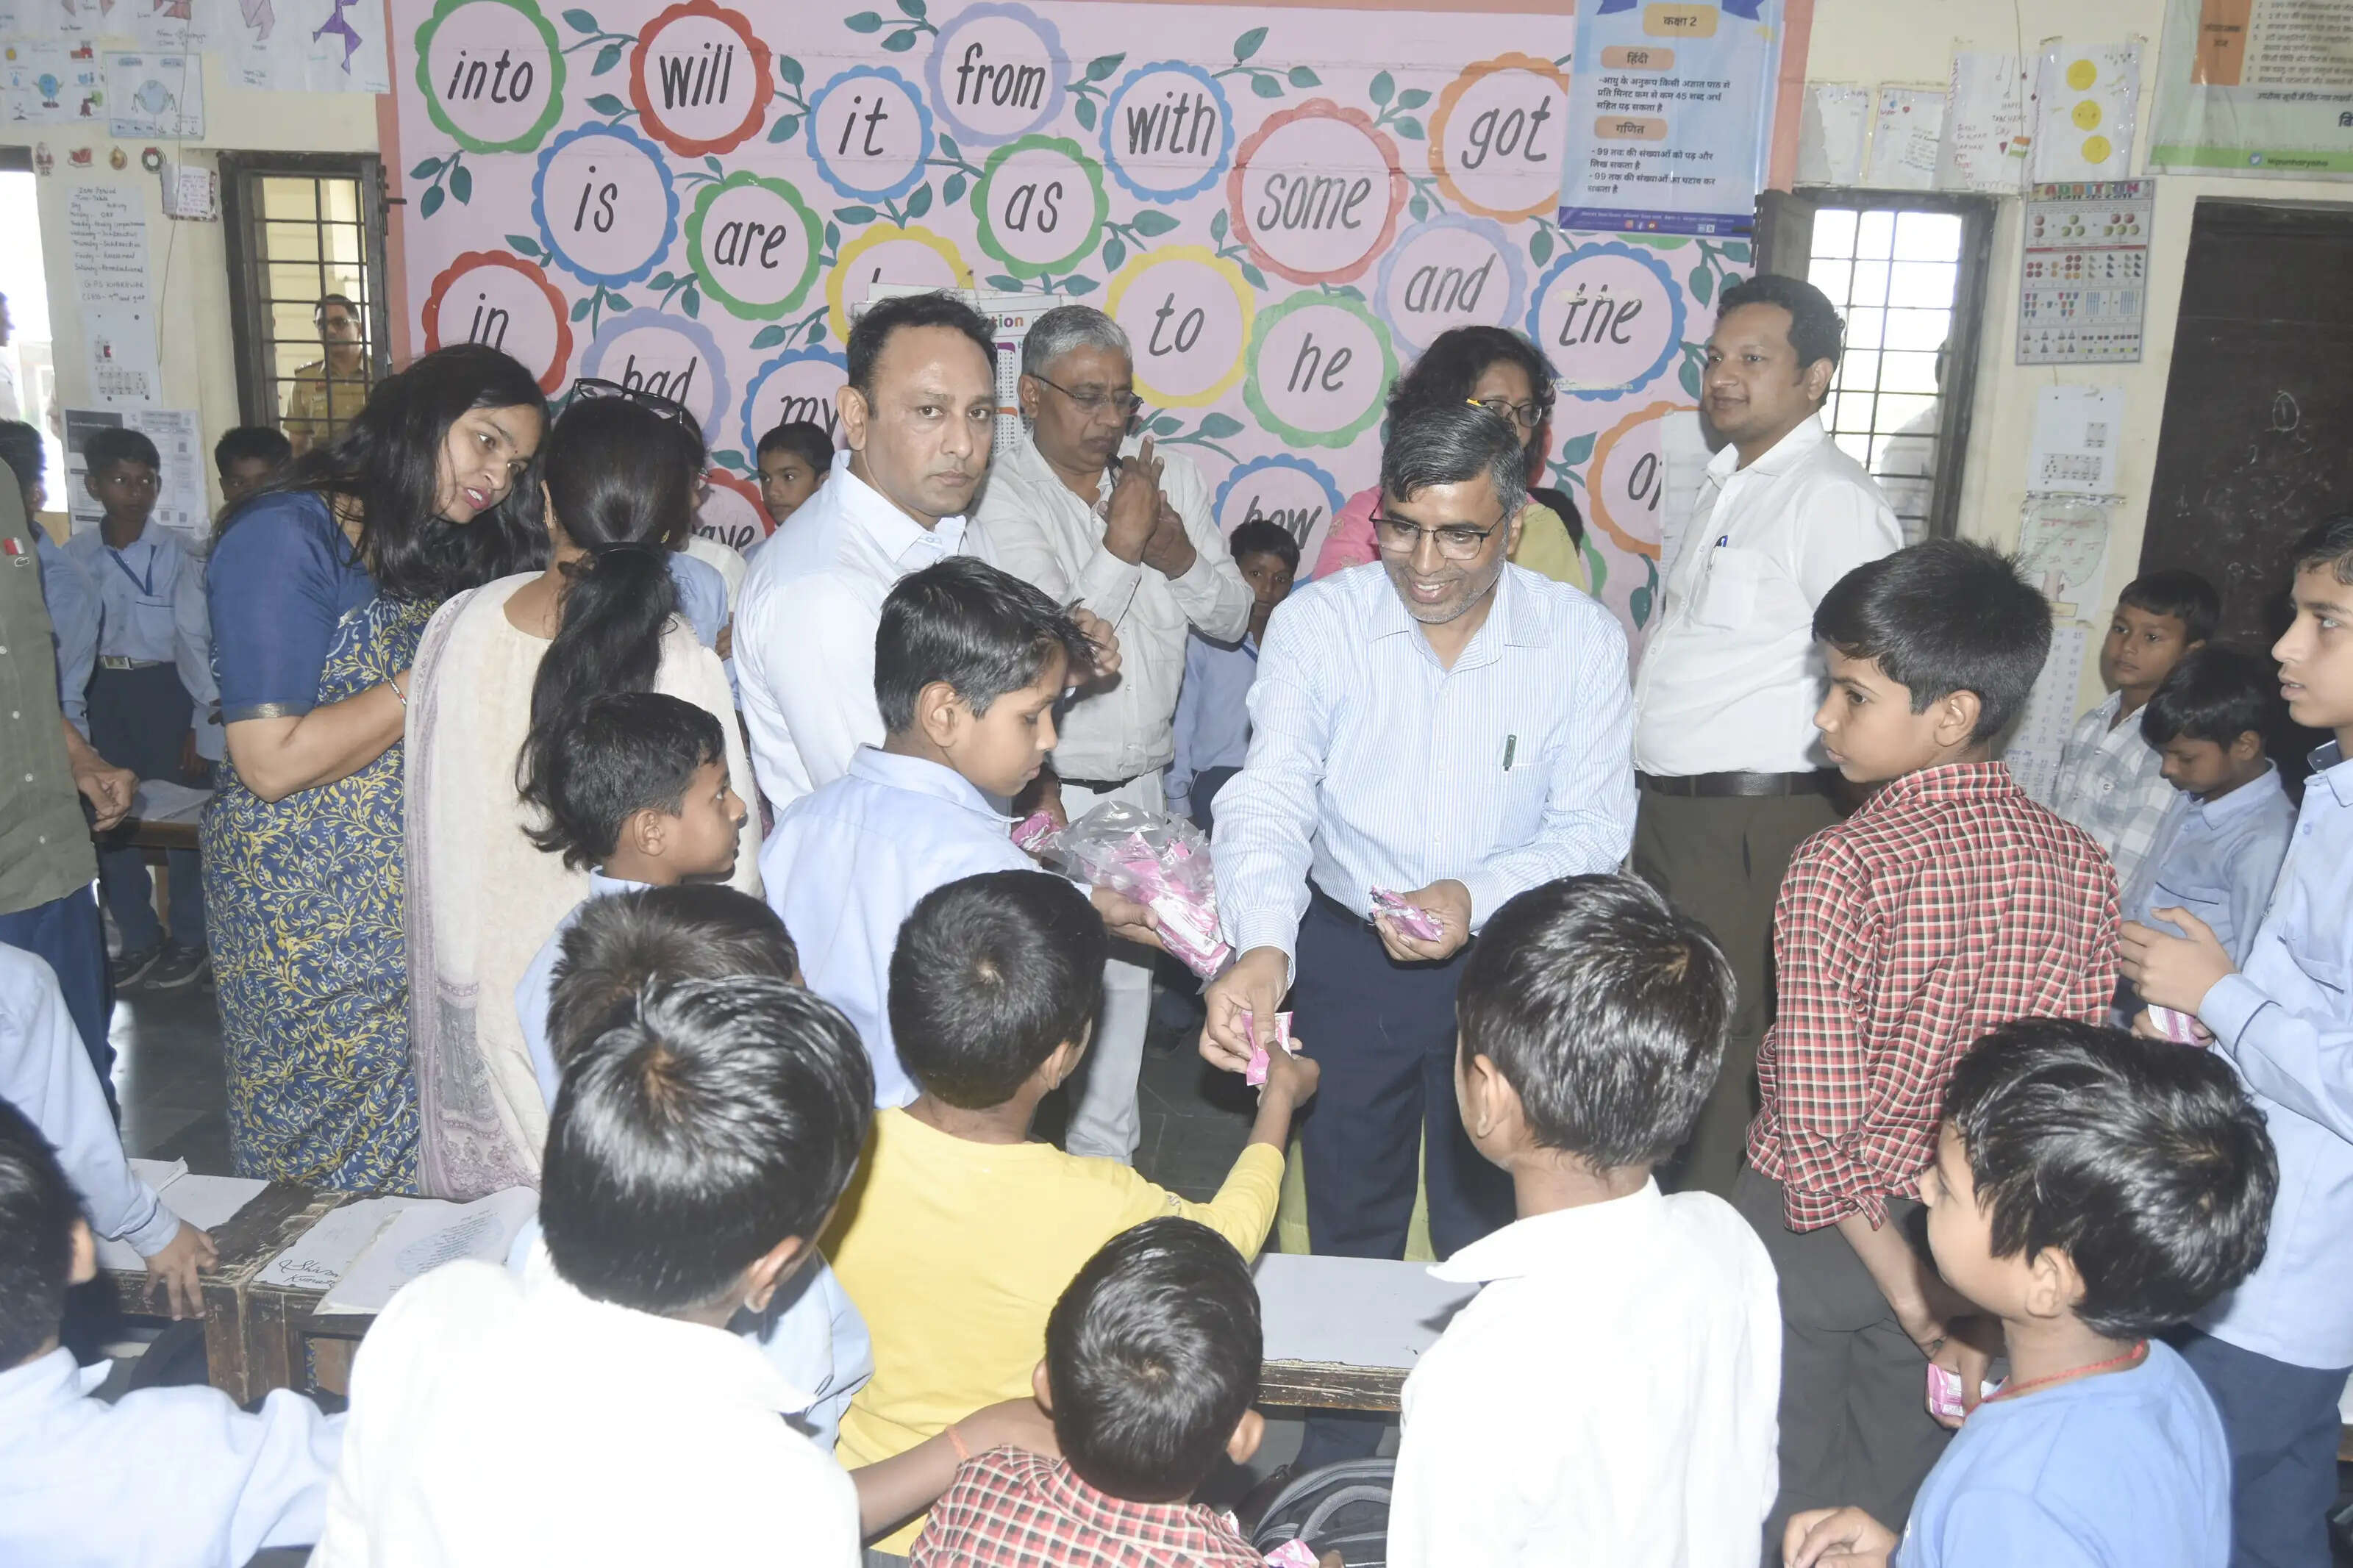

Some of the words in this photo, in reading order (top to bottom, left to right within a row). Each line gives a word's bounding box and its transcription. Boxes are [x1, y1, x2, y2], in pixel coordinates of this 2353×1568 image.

[1664, 16, 1687, 27] कक्षा
[1690, 17, 1697, 26] 2
[448, 49, 534, 103] into
[660, 43, 734, 109] will
[956, 42, 1046, 110] from
[1621, 76, 1629, 85] के
[1660, 76, 1679, 87] किसी
[1627, 52, 1649, 65] हिंदी
[1596, 101, 1615, 110] सहित
[1657, 102, 1663, 112] है
[1598, 88, 1612, 97] प्रति
[1614, 88, 1633, 98] मिनट
[1651, 90, 1657, 99] से
[1676, 92, 1687, 100] 45
[839, 96, 888, 156] it
[1127, 92, 1217, 156] with
[1461, 95, 1552, 169] got
[1616, 121, 1644, 134] गणित
[1594, 173, 1606, 181] 99
[1624, 173, 1634, 182] की
[1597, 148, 1608, 156] 99
[1627, 147, 1637, 157] की
[1699, 150, 1713, 160] और
[1610, 161, 1632, 169] सकता
[1635, 160, 1640, 171] है
[574, 165, 618, 232] is
[1005, 181, 1063, 233] as
[1257, 172, 1371, 231] some
[1613, 185, 1618, 194] है
[714, 221, 786, 268] are
[1404, 252, 1496, 312] and
[468, 293, 509, 349] in
[1149, 293, 1205, 356] to
[1558, 282, 1643, 346] the
[623, 354, 697, 404] had
[1287, 332, 1352, 393] he
[1628, 453, 1662, 511] o
[693, 524, 755, 553] ave
